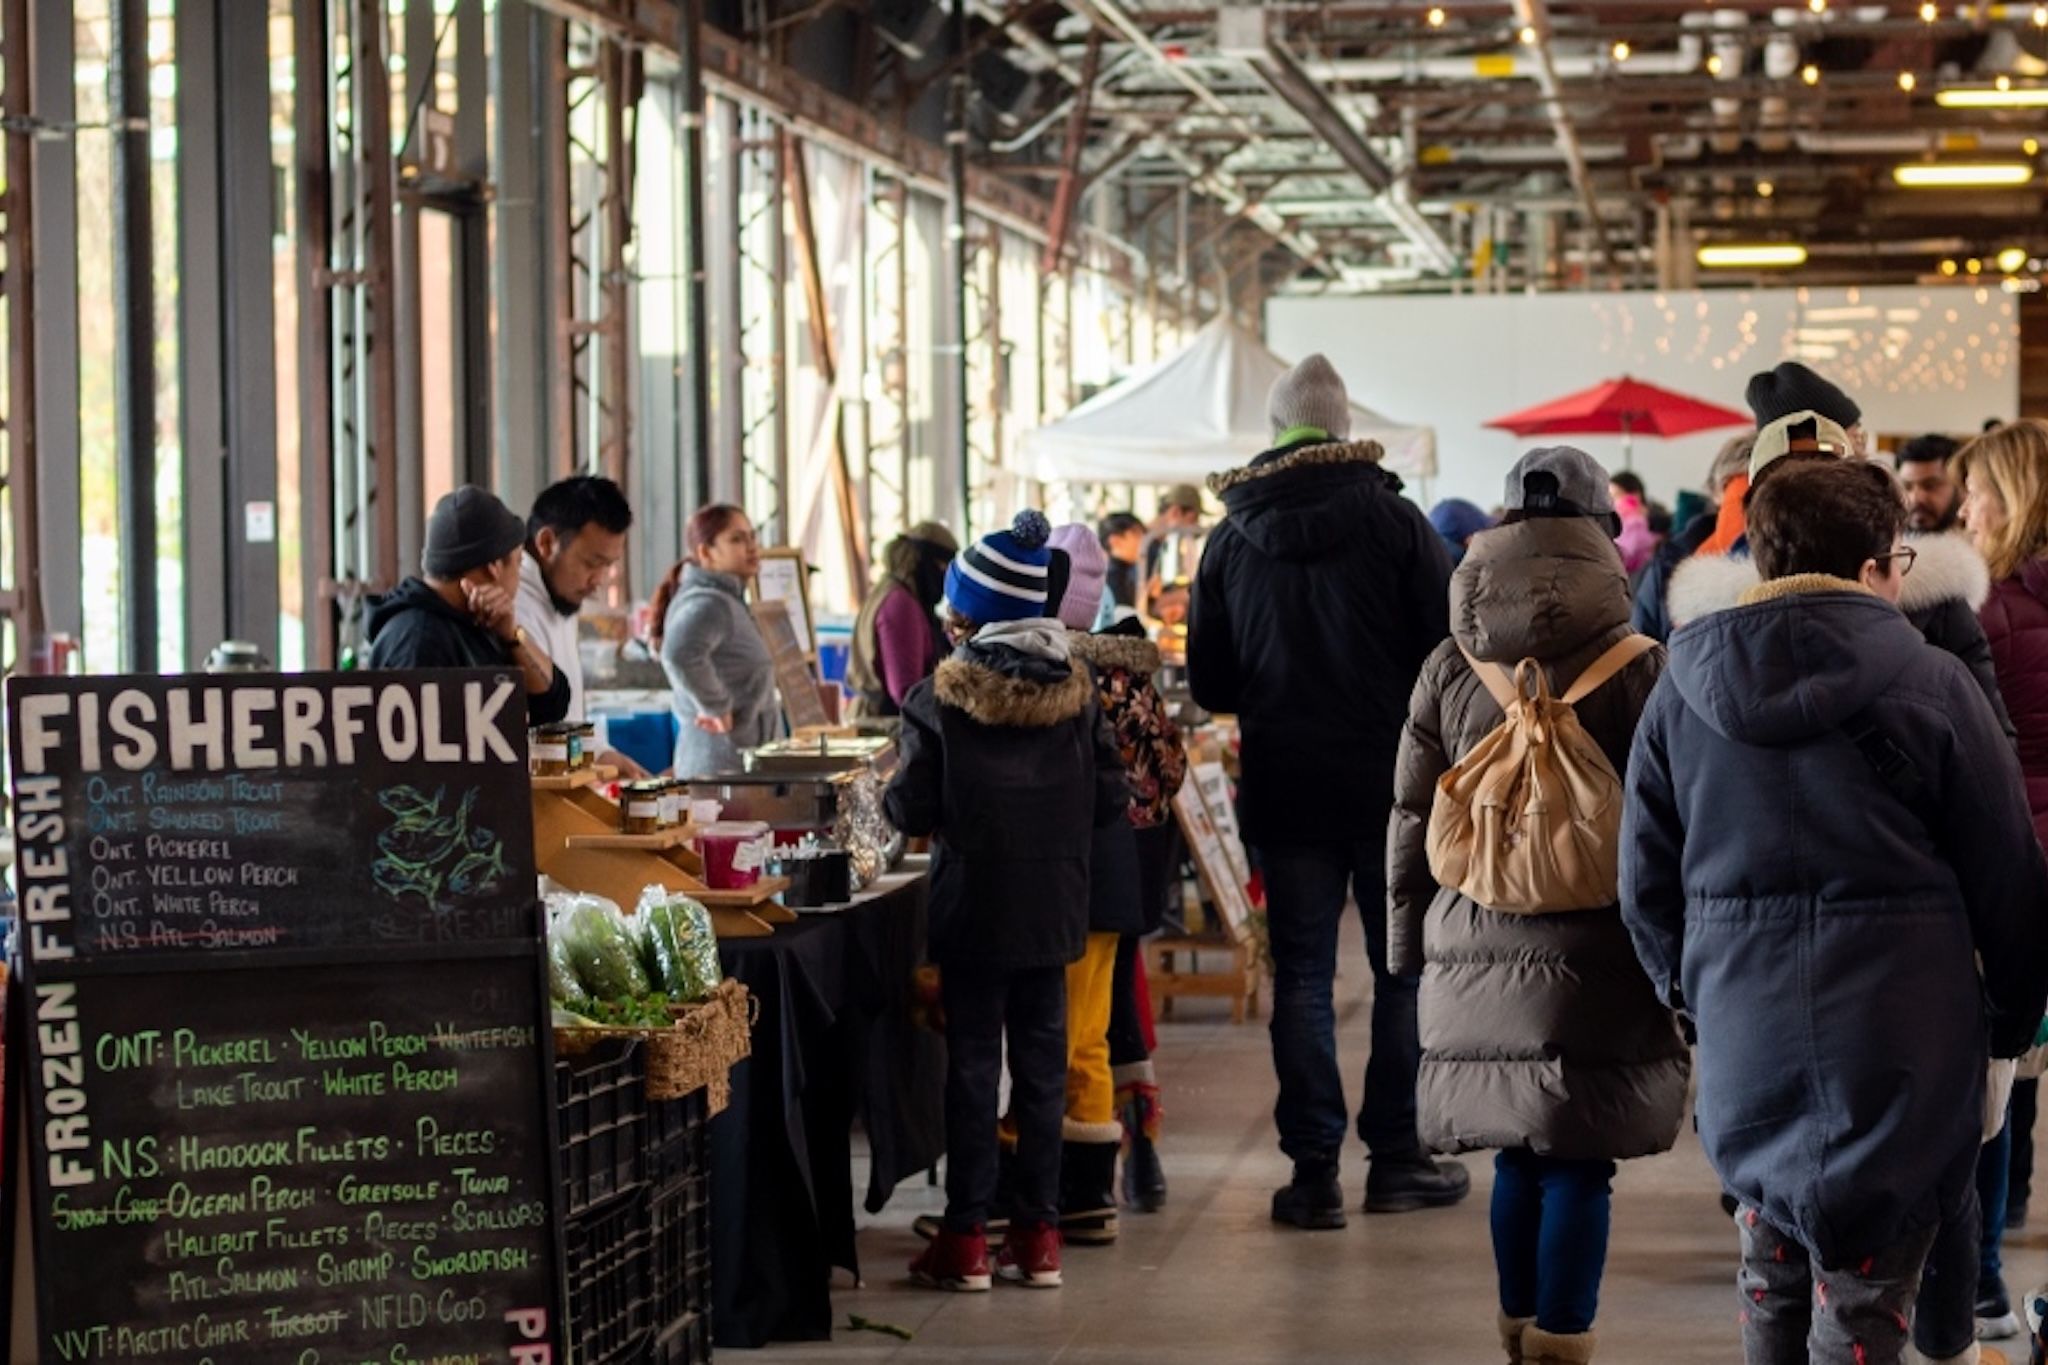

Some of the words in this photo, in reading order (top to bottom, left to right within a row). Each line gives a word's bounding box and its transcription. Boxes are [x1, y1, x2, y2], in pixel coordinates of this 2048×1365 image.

[20, 681, 518, 773] FISHERFOLK
[18, 775, 75, 960] FRESH
[146, 833, 231, 860] PICKEREL
[146, 866, 233, 886] YELLOW
[240, 862, 298, 887] PERCH
[152, 894, 201, 914] WHITE
[208, 890, 259, 915] PERCH
[173, 1027, 278, 1068] PICKEREL
[290, 1027, 367, 1061] YELLOW
[369, 1021, 428, 1058] PERCH
[35, 981, 95, 1189] FROZEN
[177, 1080, 237, 1109] LAKE
[236, 1072, 305, 1103] TROUT
[322, 1067, 386, 1096] WHITE
[392, 1061, 458, 1092] PERCH
[180, 1135, 293, 1172] HADDOCK
[297, 1126, 390, 1164] FILLETS
[416, 1115, 495, 1157] PIECES
[168, 1181, 245, 1219] OCEAN
[252, 1175, 316, 1212] PERCH
[451, 1167, 510, 1196] TUNA
[164, 1228, 259, 1259] HALIBUT
[266, 1217, 349, 1249] FILLETS
[364, 1210, 438, 1242] PIECES
[217, 1256, 298, 1296] SALMON
[316, 1251, 395, 1288] SHRIMP
[411, 1244, 529, 1281] SWORDFISH
